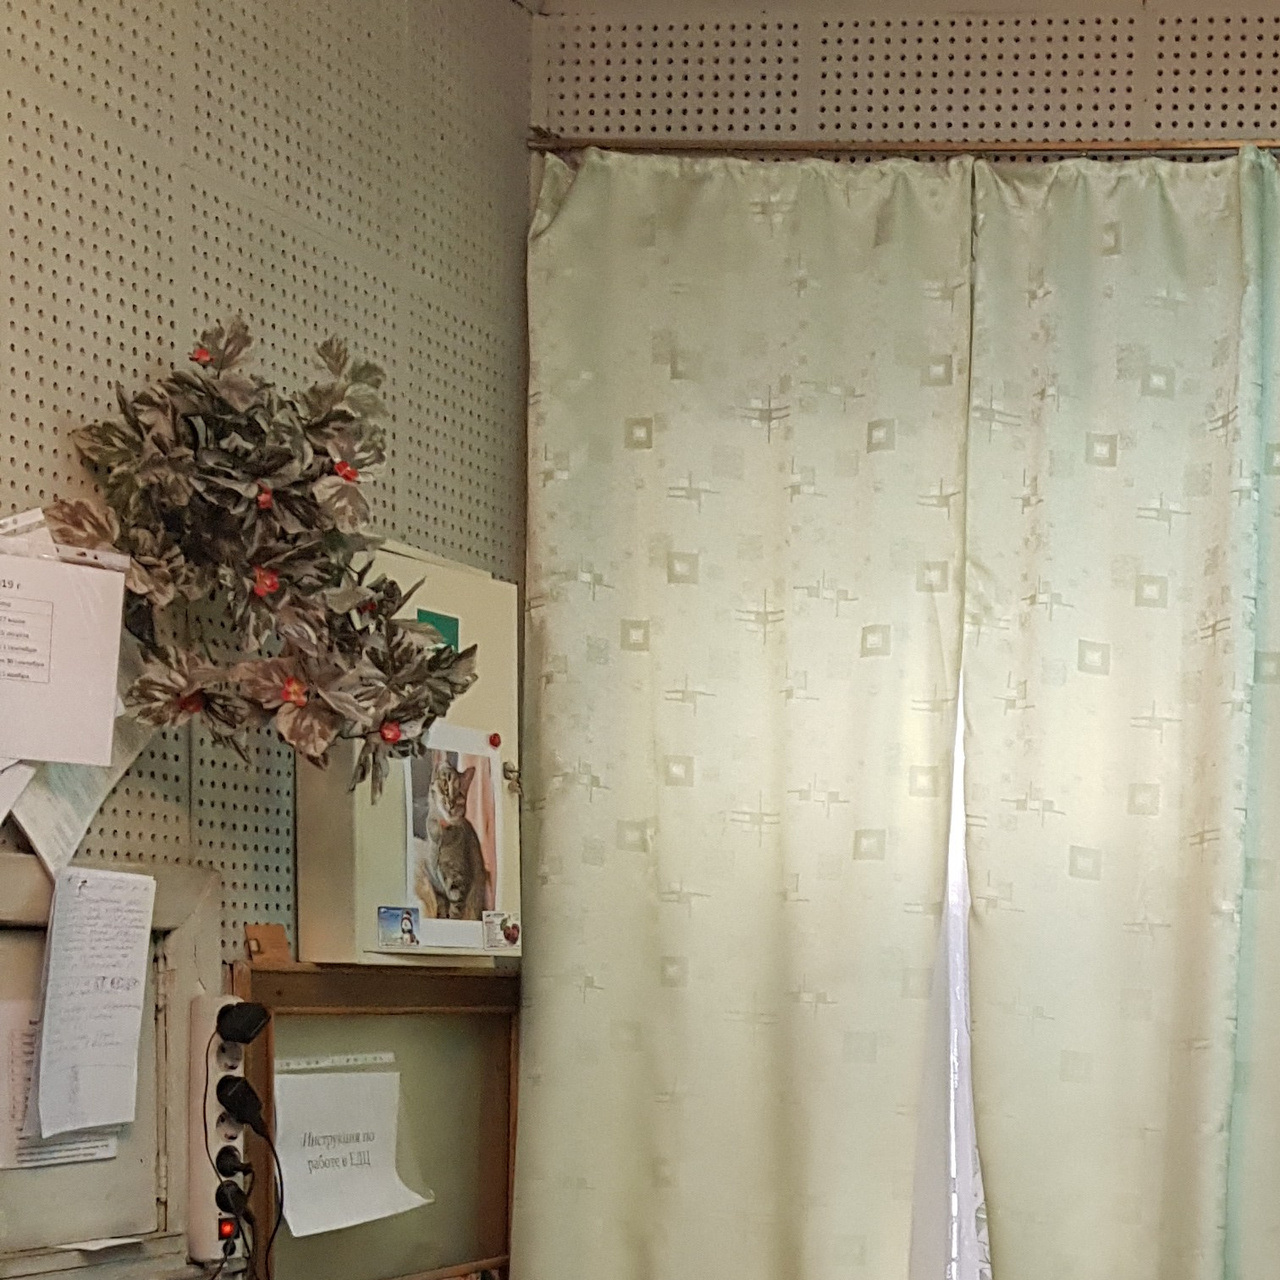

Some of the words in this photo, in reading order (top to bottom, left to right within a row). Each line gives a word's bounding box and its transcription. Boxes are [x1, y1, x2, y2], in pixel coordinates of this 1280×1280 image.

[302, 1131, 361, 1150] Инструкция
[362, 1132, 375, 1142] по
[307, 1154, 340, 1175] работе
